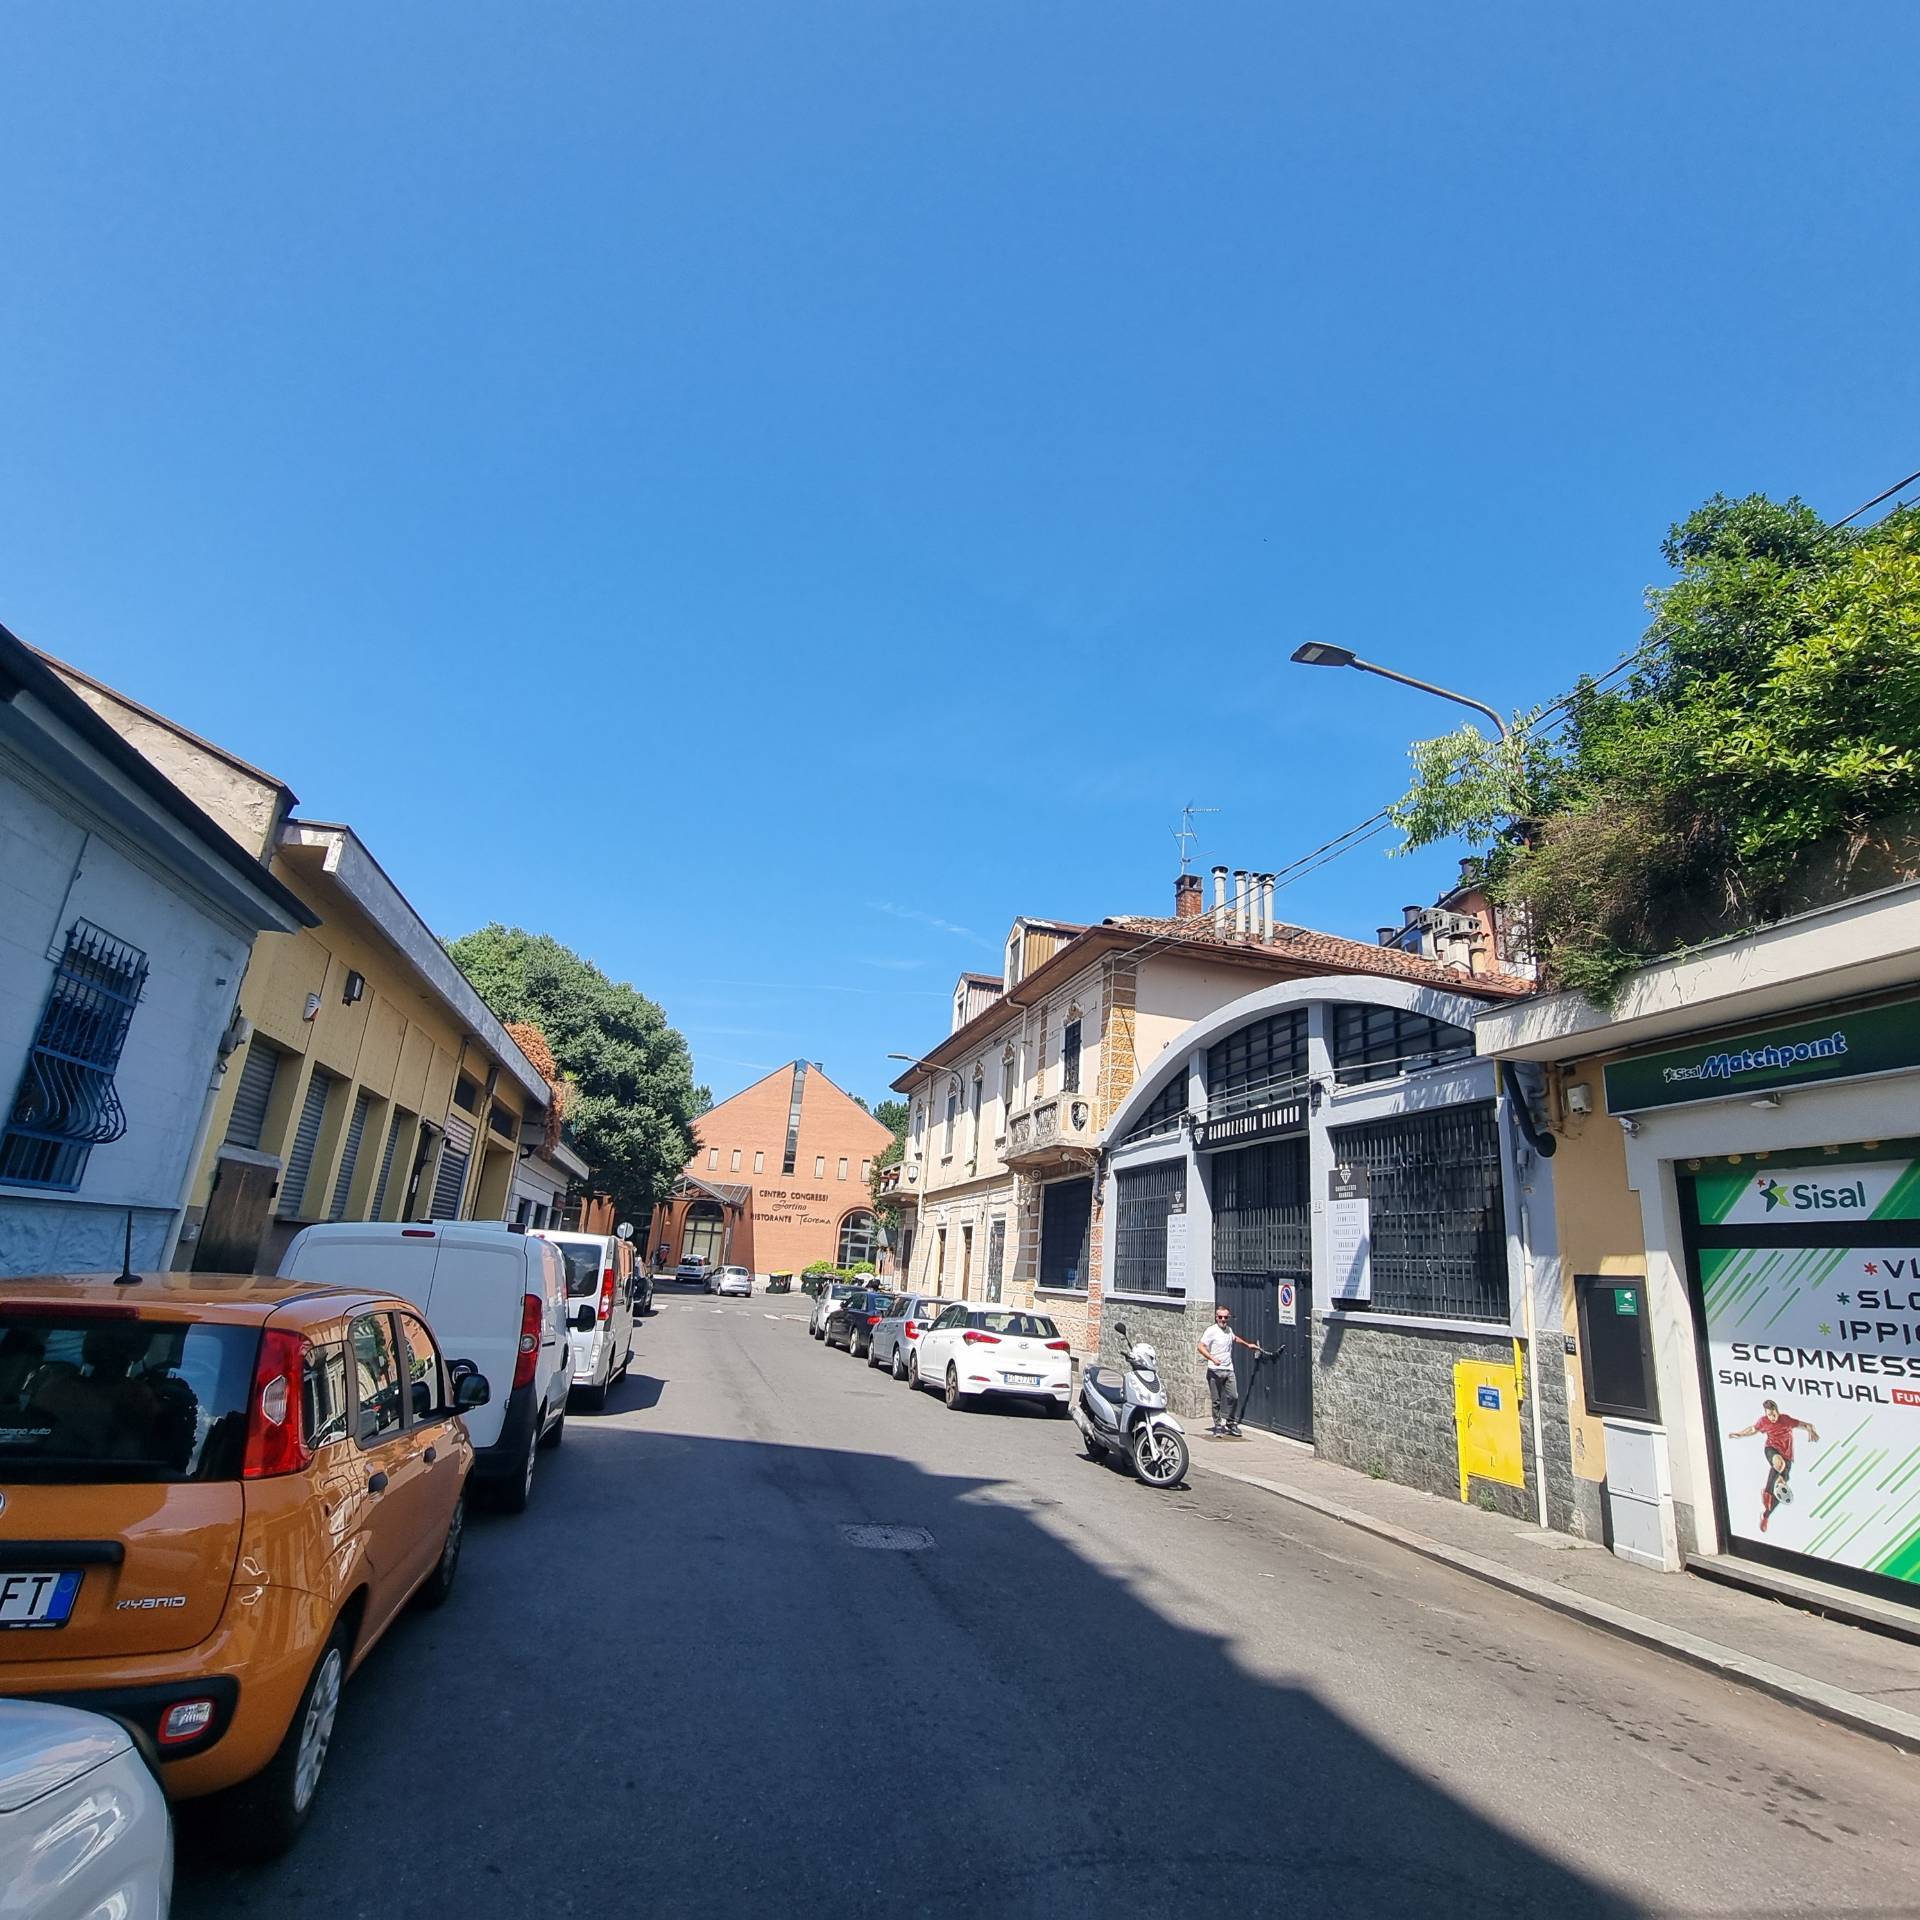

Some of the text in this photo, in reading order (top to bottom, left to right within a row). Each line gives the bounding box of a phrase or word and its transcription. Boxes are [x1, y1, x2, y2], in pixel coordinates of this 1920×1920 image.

[1676, 1031, 1848, 1081] Sisal Matchpoint
[759, 1189, 829, 1202] CENTRO CONGRESSI
[1793, 1181, 1866, 1210] Sisal
[796, 1213, 831, 1225] Teorema
[1839, 1320, 1920, 1345] IPPI
[1718, 1369, 1777, 1391] SALA
[1782, 1377, 1890, 1404] VIRTUAL
[116, 1596, 187, 1610] HYBRID
